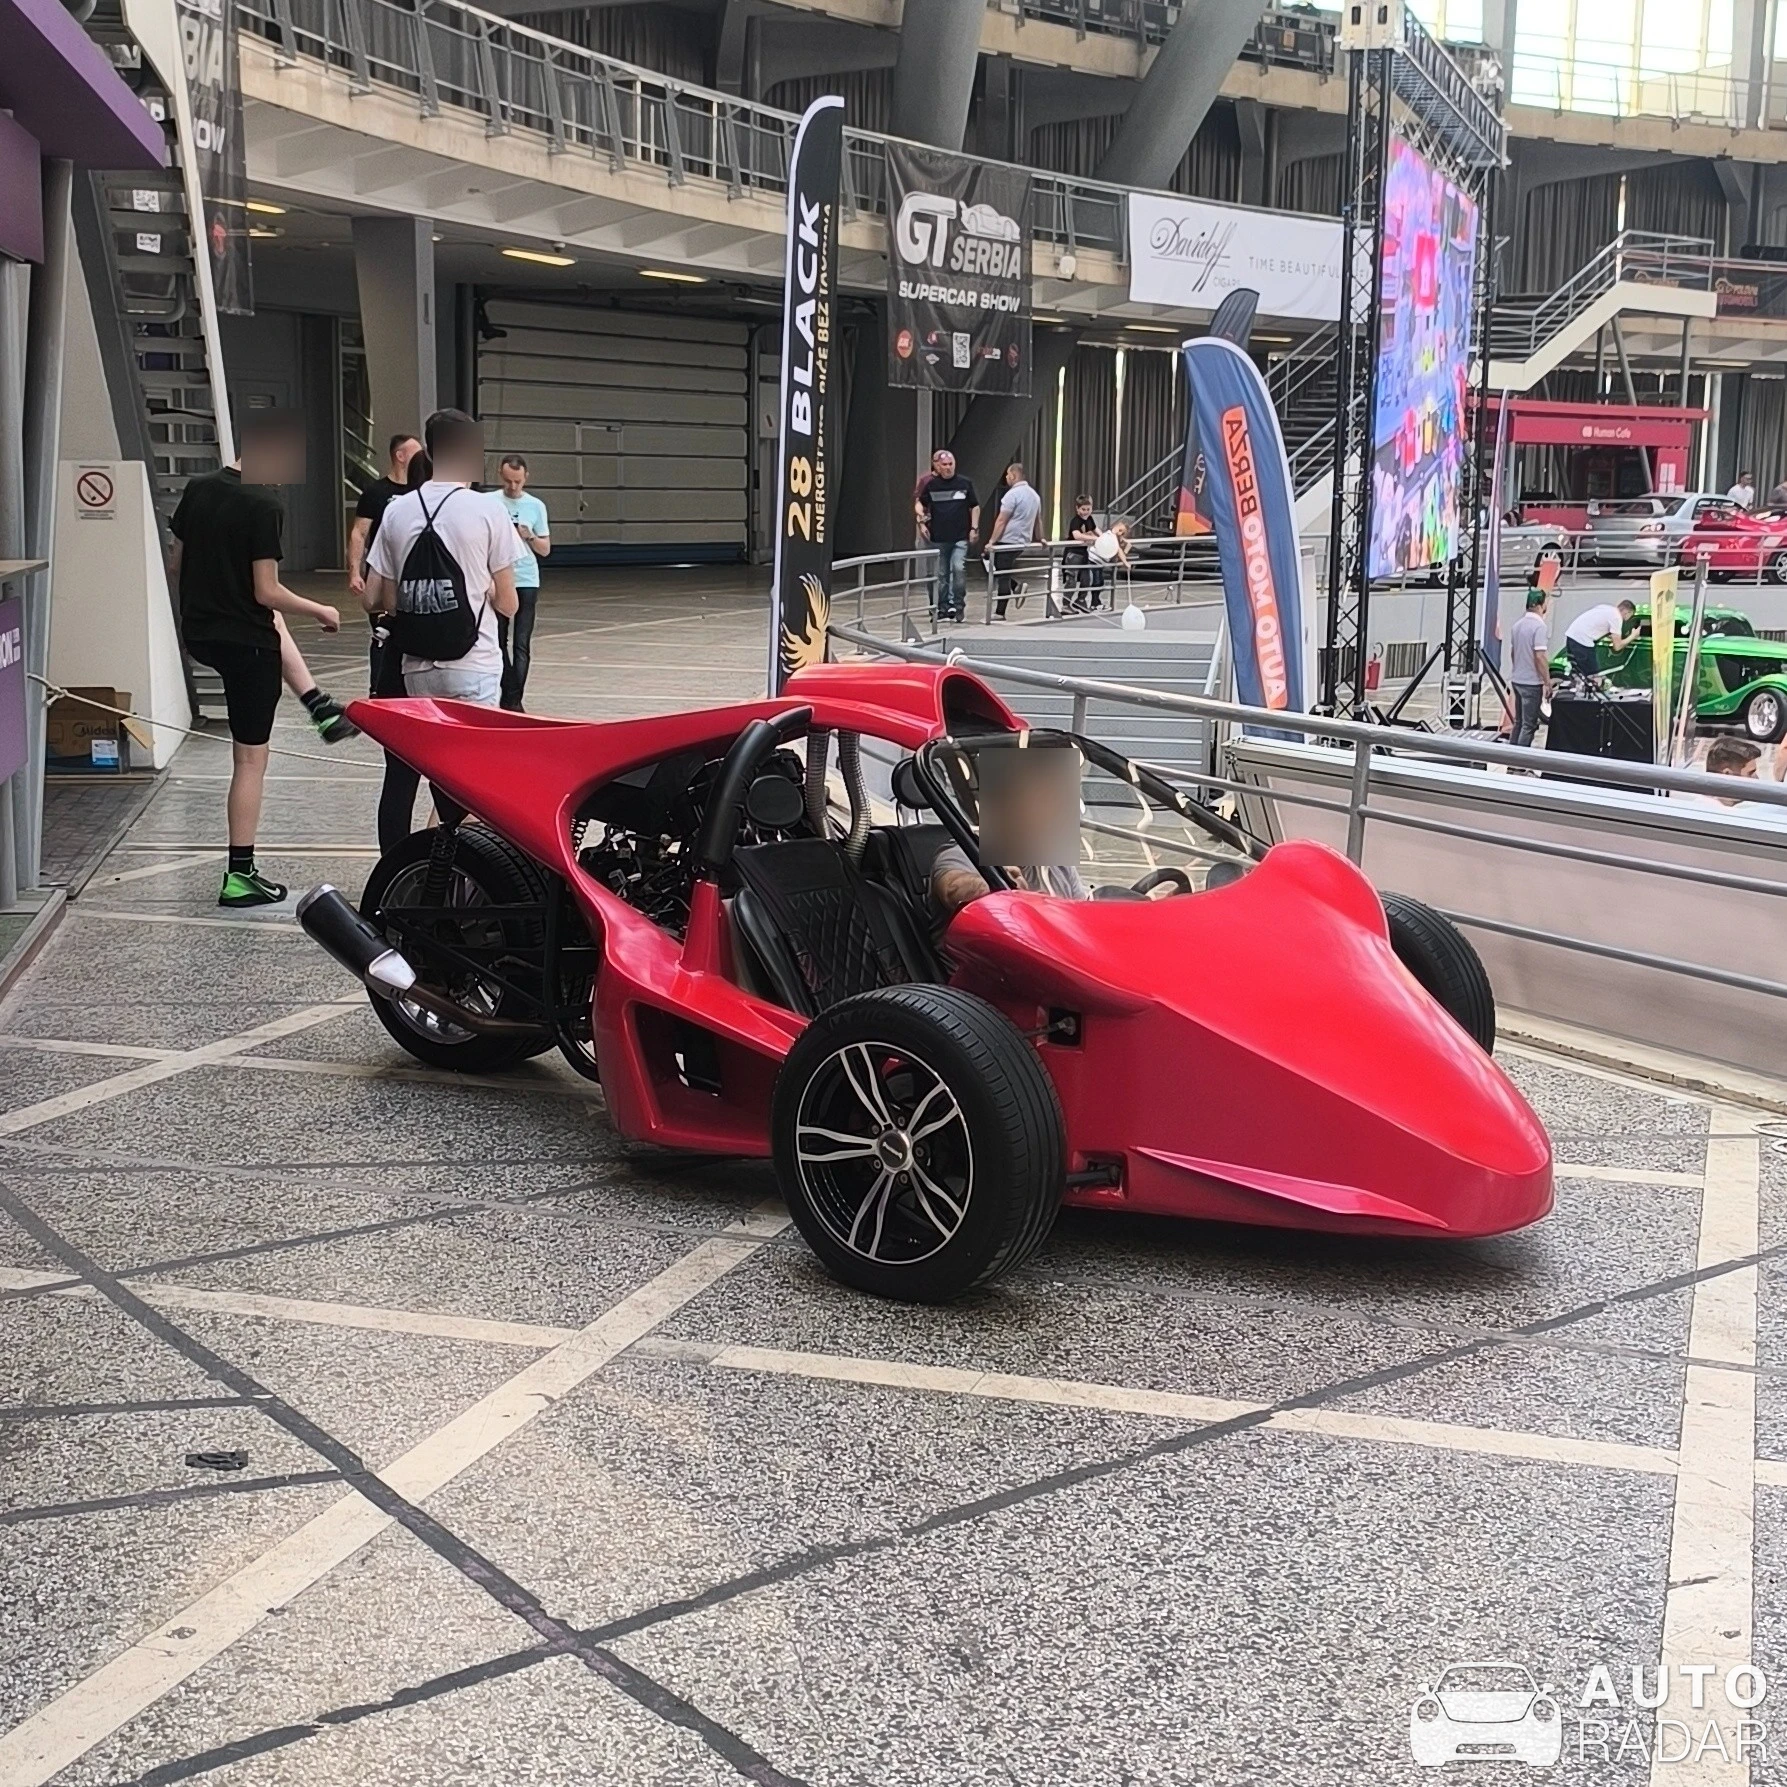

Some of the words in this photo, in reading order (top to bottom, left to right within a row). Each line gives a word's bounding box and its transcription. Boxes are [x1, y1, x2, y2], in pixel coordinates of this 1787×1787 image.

[180, 14, 224, 92] BIA
[192, 117, 226, 154] OW
[897, 191, 957, 267] GT
[951, 236, 1021, 280] SERBIA
[1150, 217, 1238, 292] Davidoff
[899, 281, 978, 307] SUPERCAR
[980, 293, 1021, 312] SHOW
[1249, 256, 1275, 272] TIME
[1280, 260, 1340, 278] BEAUTIFUL
[791, 192, 820, 435] BLACK
[818, 301, 830, 342] BEZ
[788, 456, 812, 541] 28
